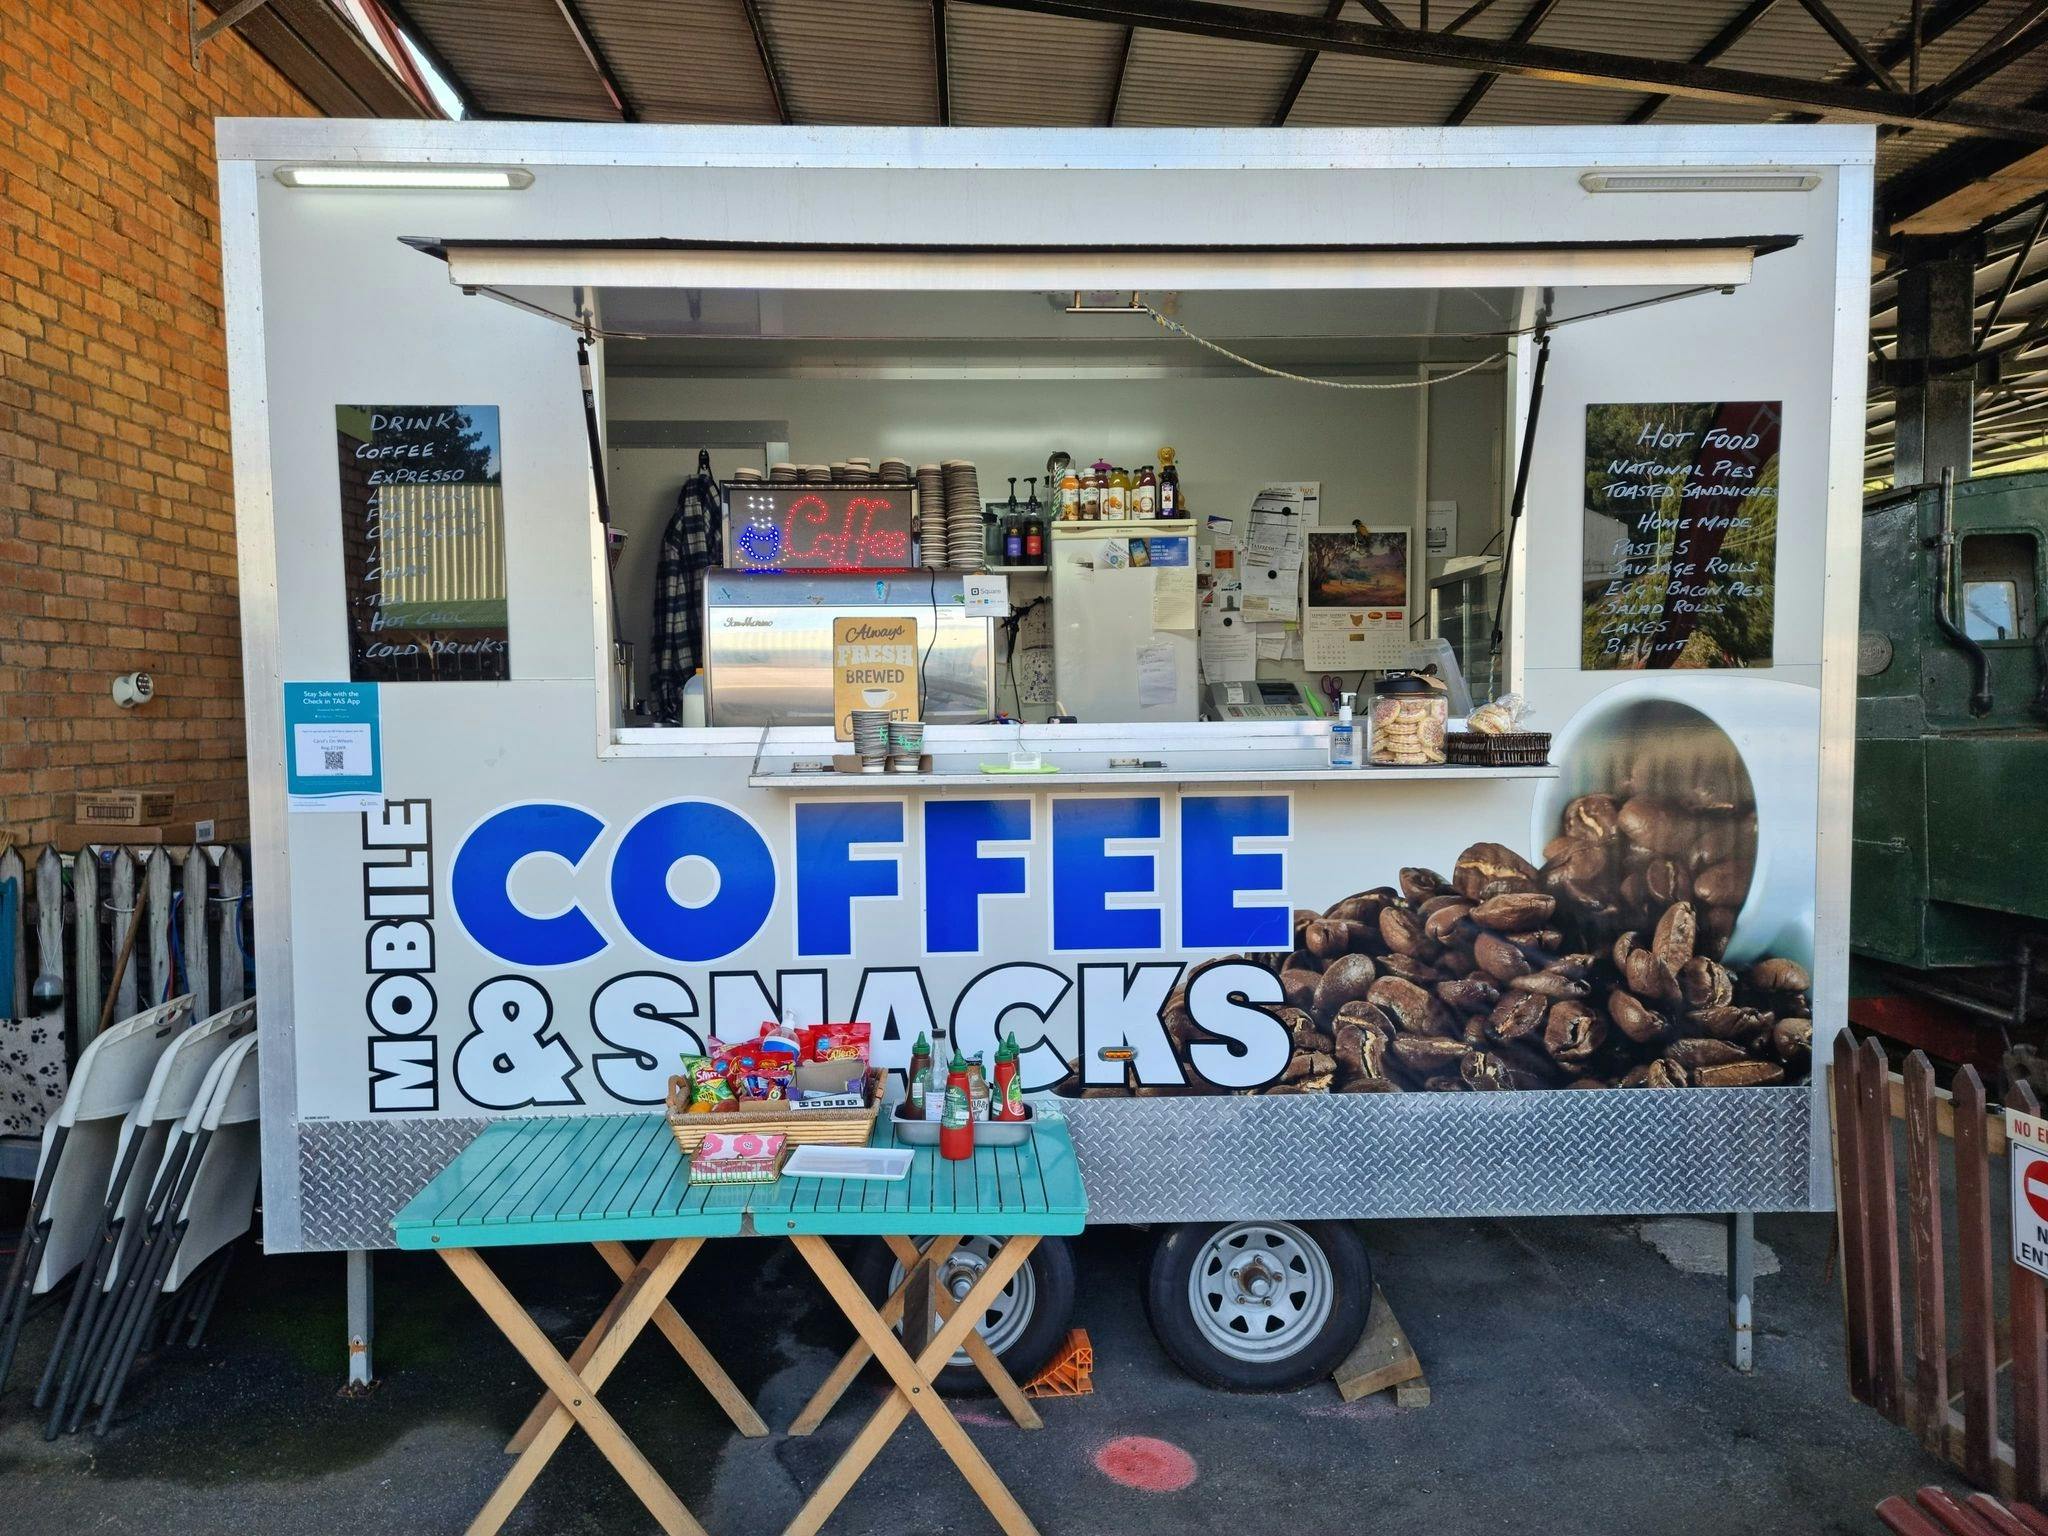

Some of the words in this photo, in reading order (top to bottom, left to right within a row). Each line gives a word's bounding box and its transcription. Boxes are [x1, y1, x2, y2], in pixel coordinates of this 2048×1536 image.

[370, 413, 471, 432] DRINKS
[1637, 423, 1695, 449] HOT
[1701, 428, 1760, 449] FOOD
[355, 442, 434, 459] COFFEE
[367, 468, 465, 486] EXPRESSO
[1607, 460, 1705, 477] NATIONAL
[1712, 460, 1756, 478] PIES
[1602, 481, 1675, 498] TOASTED
[1680, 482, 1778, 497] SANDWICHES
[1637, 511, 1690, 529] HOME
[1697, 515, 1752, 529] MADE
[783, 495, 908, 569] Coffee
[1612, 538, 1692, 555] PASTIES
[1609, 559, 1697, 576] SAUSAGE
[1704, 557, 1758, 574] ROLLS
[1603, 581, 1648, 598] EGG
[1665, 581, 1727, 597] BACON
[1728, 581, 1764, 598] PIES
[1601, 602, 1665, 616] SALAD
[1673, 600, 1726, 614] ROLLS
[371, 612, 413, 631] HOT
[1600, 620, 1671, 635] CAKES
[845, 623, 905, 644] Always
[366, 642, 419, 658] COLD
[429, 638, 507, 655] DRINKS
[837, 644, 914, 668] FRESH
[846, 668, 905, 685] BREWED
[346, 698, 361, 706] App
[446, 793, 1294, 970] COFFEE
[362, 798, 438, 1112] MOBILE
[453, 974, 586, 1110] &
[590, 959, 1294, 1106] SNACKS
[2014, 1119, 2031, 1138] NO
